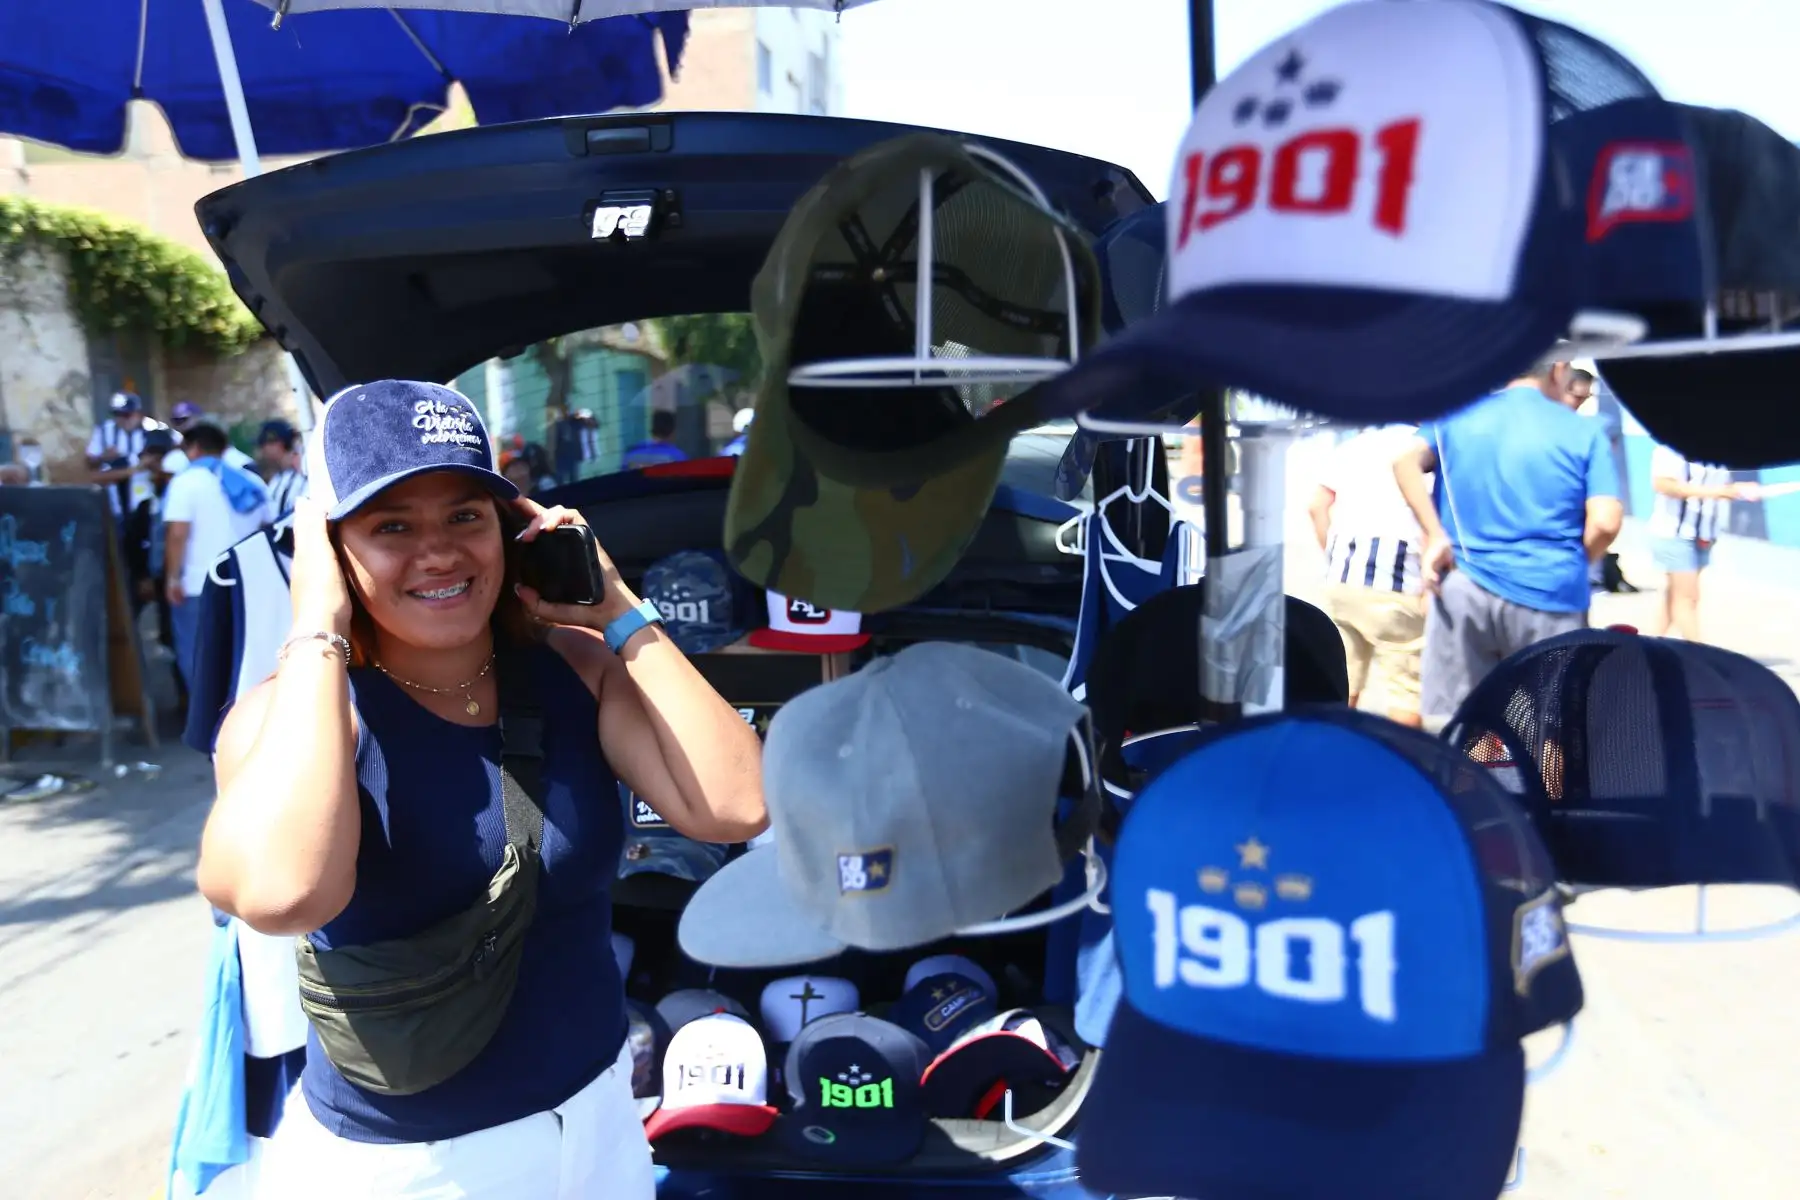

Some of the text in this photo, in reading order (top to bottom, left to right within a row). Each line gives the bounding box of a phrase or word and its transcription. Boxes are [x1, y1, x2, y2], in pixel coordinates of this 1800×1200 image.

[1176, 114, 1421, 252] 1901
[1146, 888, 1395, 1022] 1901
[678, 1063, 745, 1091] 1901
[819, 1076, 894, 1108] 1901
